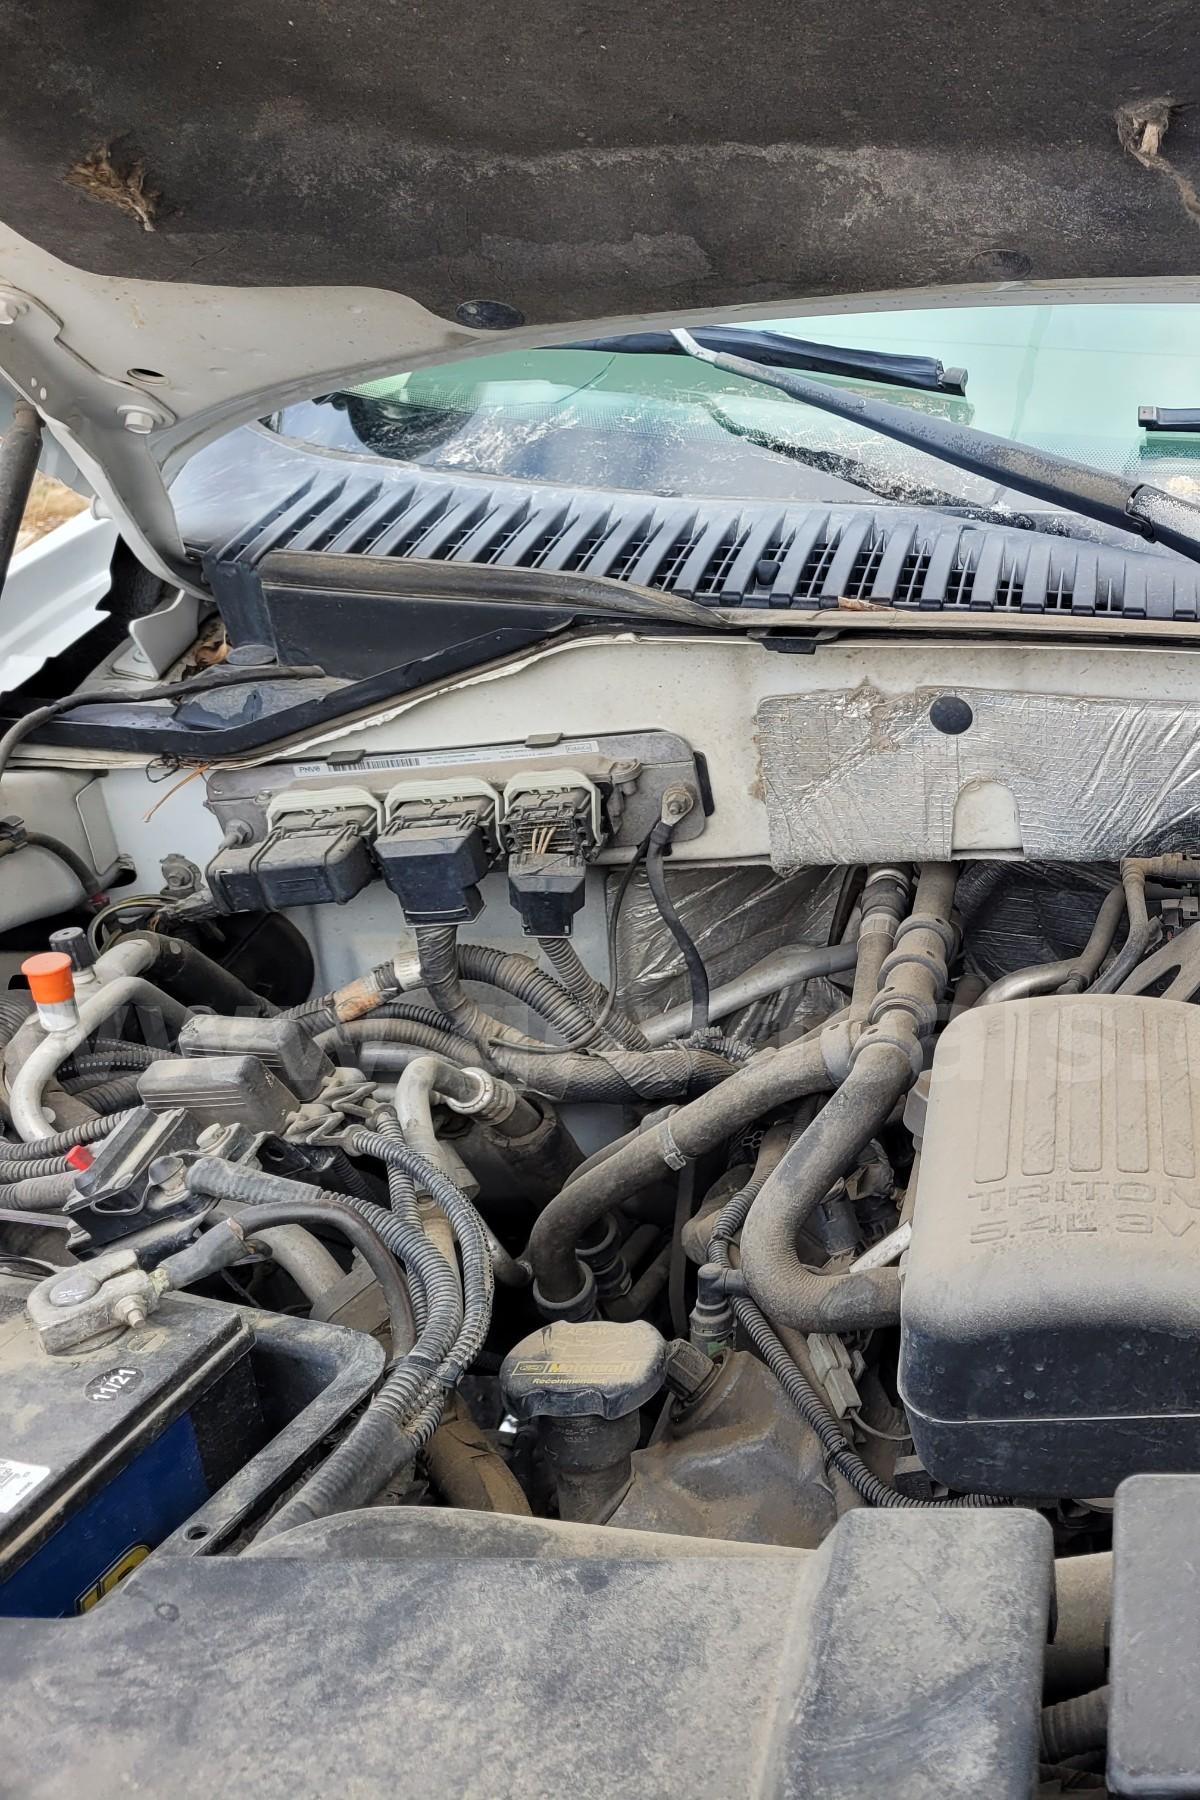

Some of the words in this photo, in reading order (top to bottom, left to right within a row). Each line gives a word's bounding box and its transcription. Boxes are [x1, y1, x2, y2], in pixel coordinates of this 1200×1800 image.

[970, 1213, 1098, 1244] 5.4L
[1114, 1213, 1196, 1238] 3V
[93, 1369, 137, 1400] 11/21
